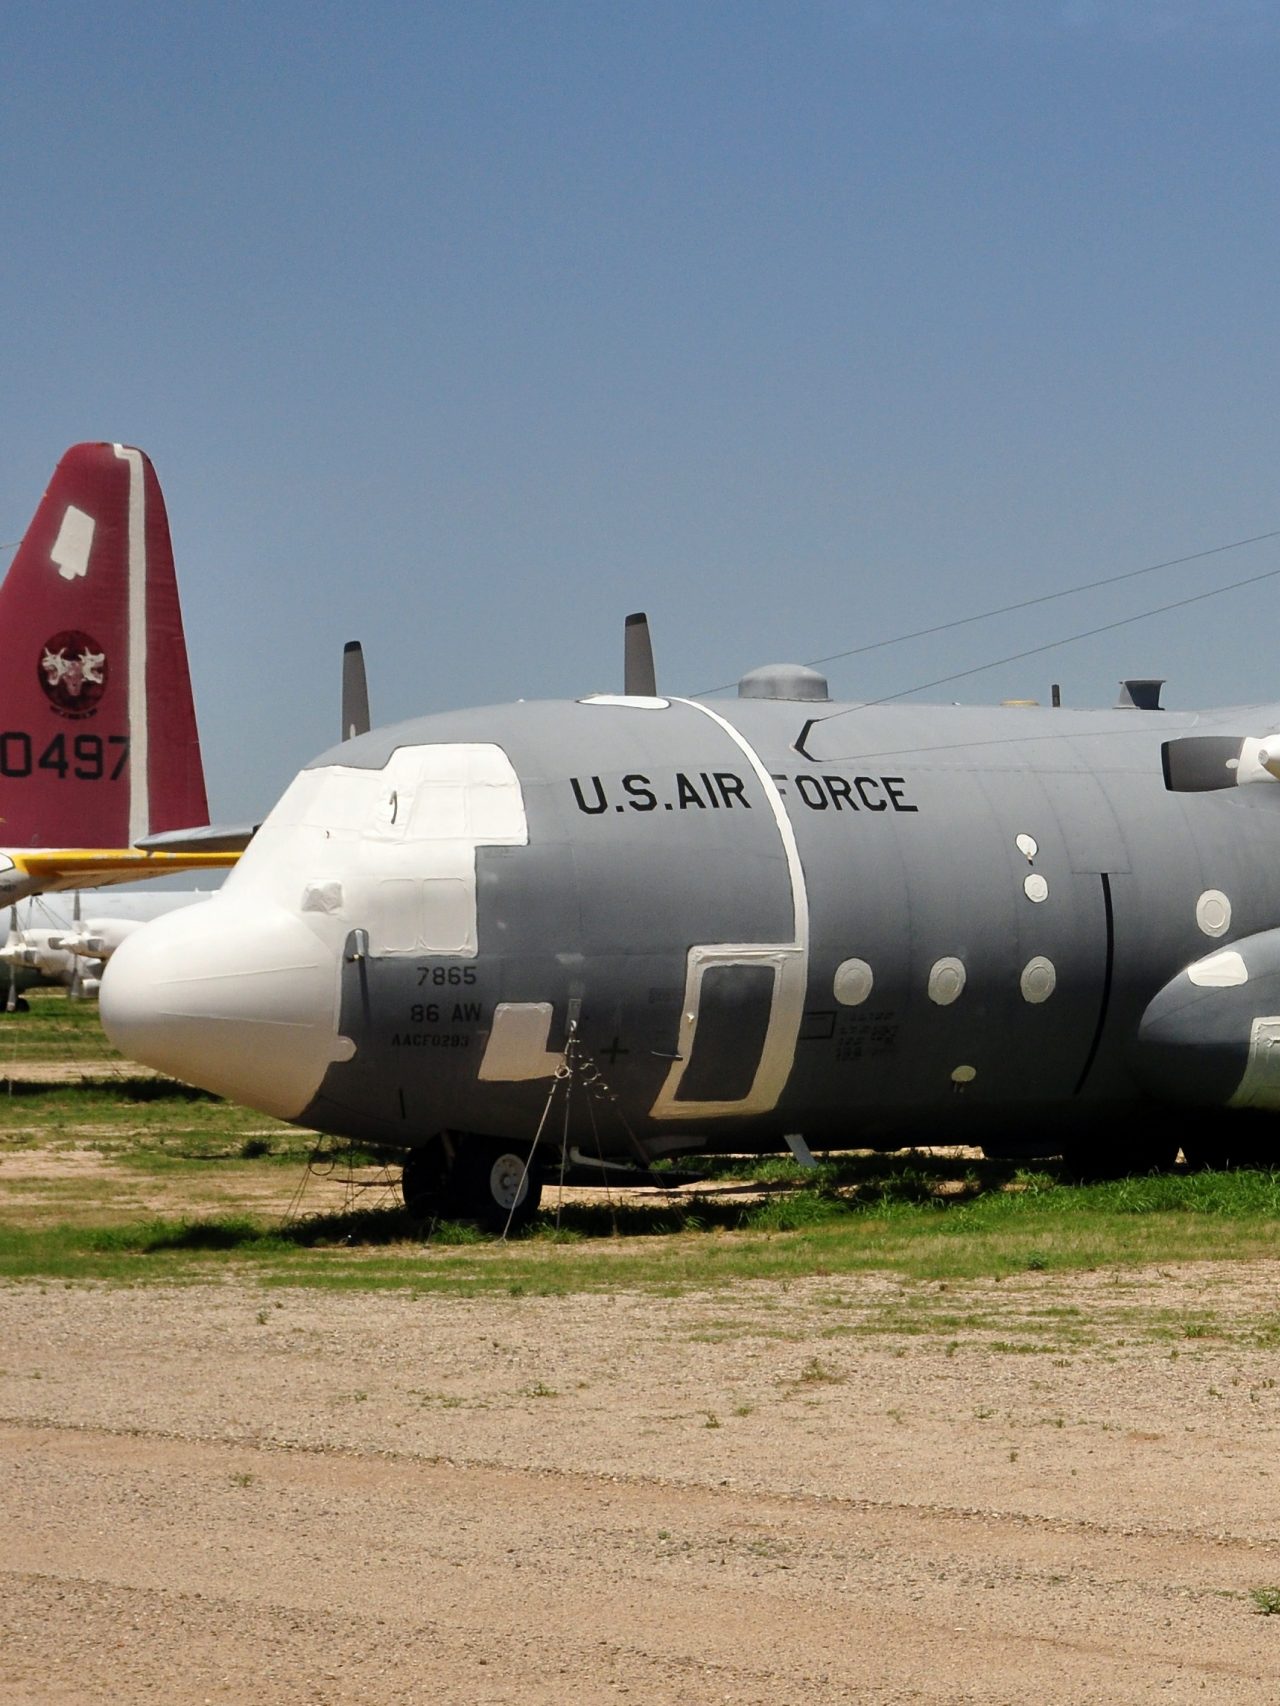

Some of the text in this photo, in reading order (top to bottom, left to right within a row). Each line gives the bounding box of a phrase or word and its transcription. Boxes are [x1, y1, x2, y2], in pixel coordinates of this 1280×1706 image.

[0, 732, 129, 780] 0497
[417, 966, 477, 986] 7865
[411, 1004, 482, 1023] 86 AW
